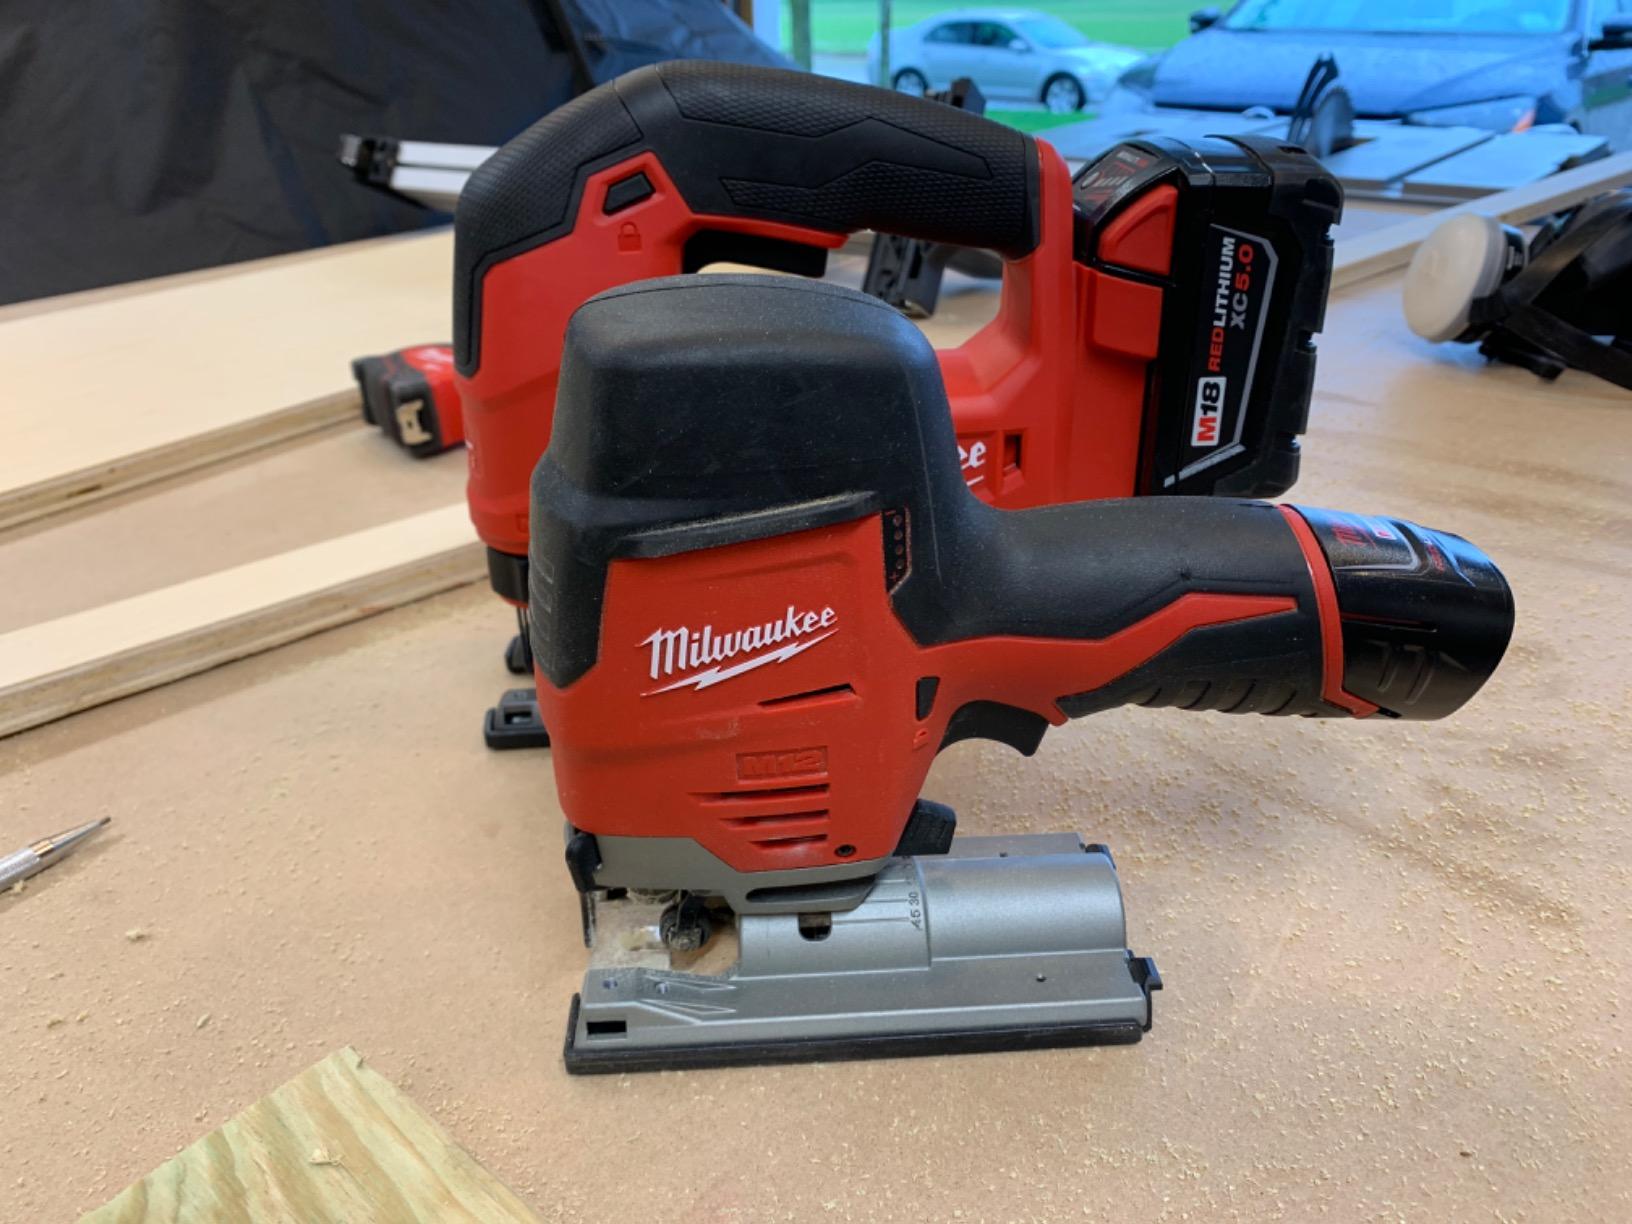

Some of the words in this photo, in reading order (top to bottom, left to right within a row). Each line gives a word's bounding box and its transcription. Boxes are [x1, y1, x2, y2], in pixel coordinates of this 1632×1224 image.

[1208, 236, 1236, 372] REDLITHIUM
[1230, 243, 1254, 331] XC5.0
[1197, 381, 1221, 442] M18
[635, 604, 838, 680] Milwaukee
